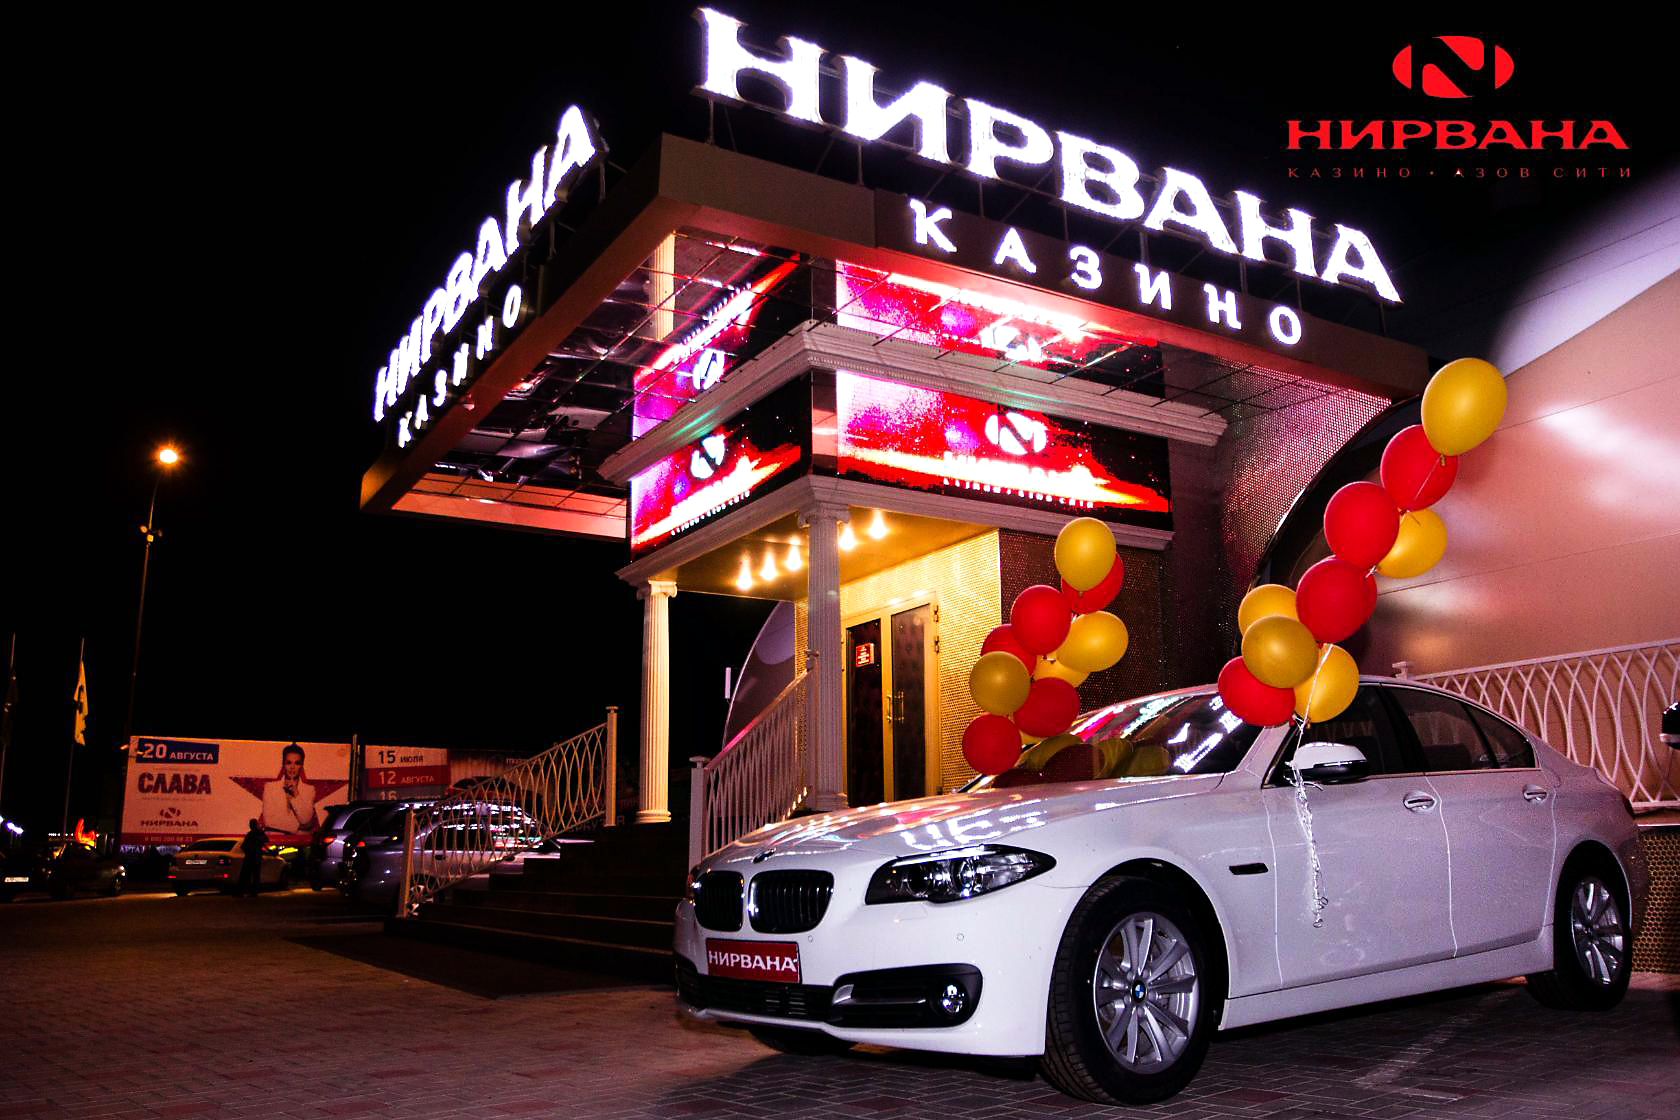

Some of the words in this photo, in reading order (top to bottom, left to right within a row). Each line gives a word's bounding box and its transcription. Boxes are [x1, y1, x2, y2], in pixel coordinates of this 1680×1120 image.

[698, 7, 1403, 304] НИРВАНА
[373, 104, 597, 424] НИРВАНА
[908, 198, 1303, 346] КАЗИНО
[397, 283, 524, 450] КАЗИНО
[142, 743, 167, 759] 20
[169, 751, 214, 761] АВГУСТА
[378, 750, 396, 764] 15
[138, 772, 212, 794] СЛАВА
[378, 770, 397, 785] 12
[400, 775, 435, 784] АВГУСТА
[707, 950, 797, 972] НИРВАНА
